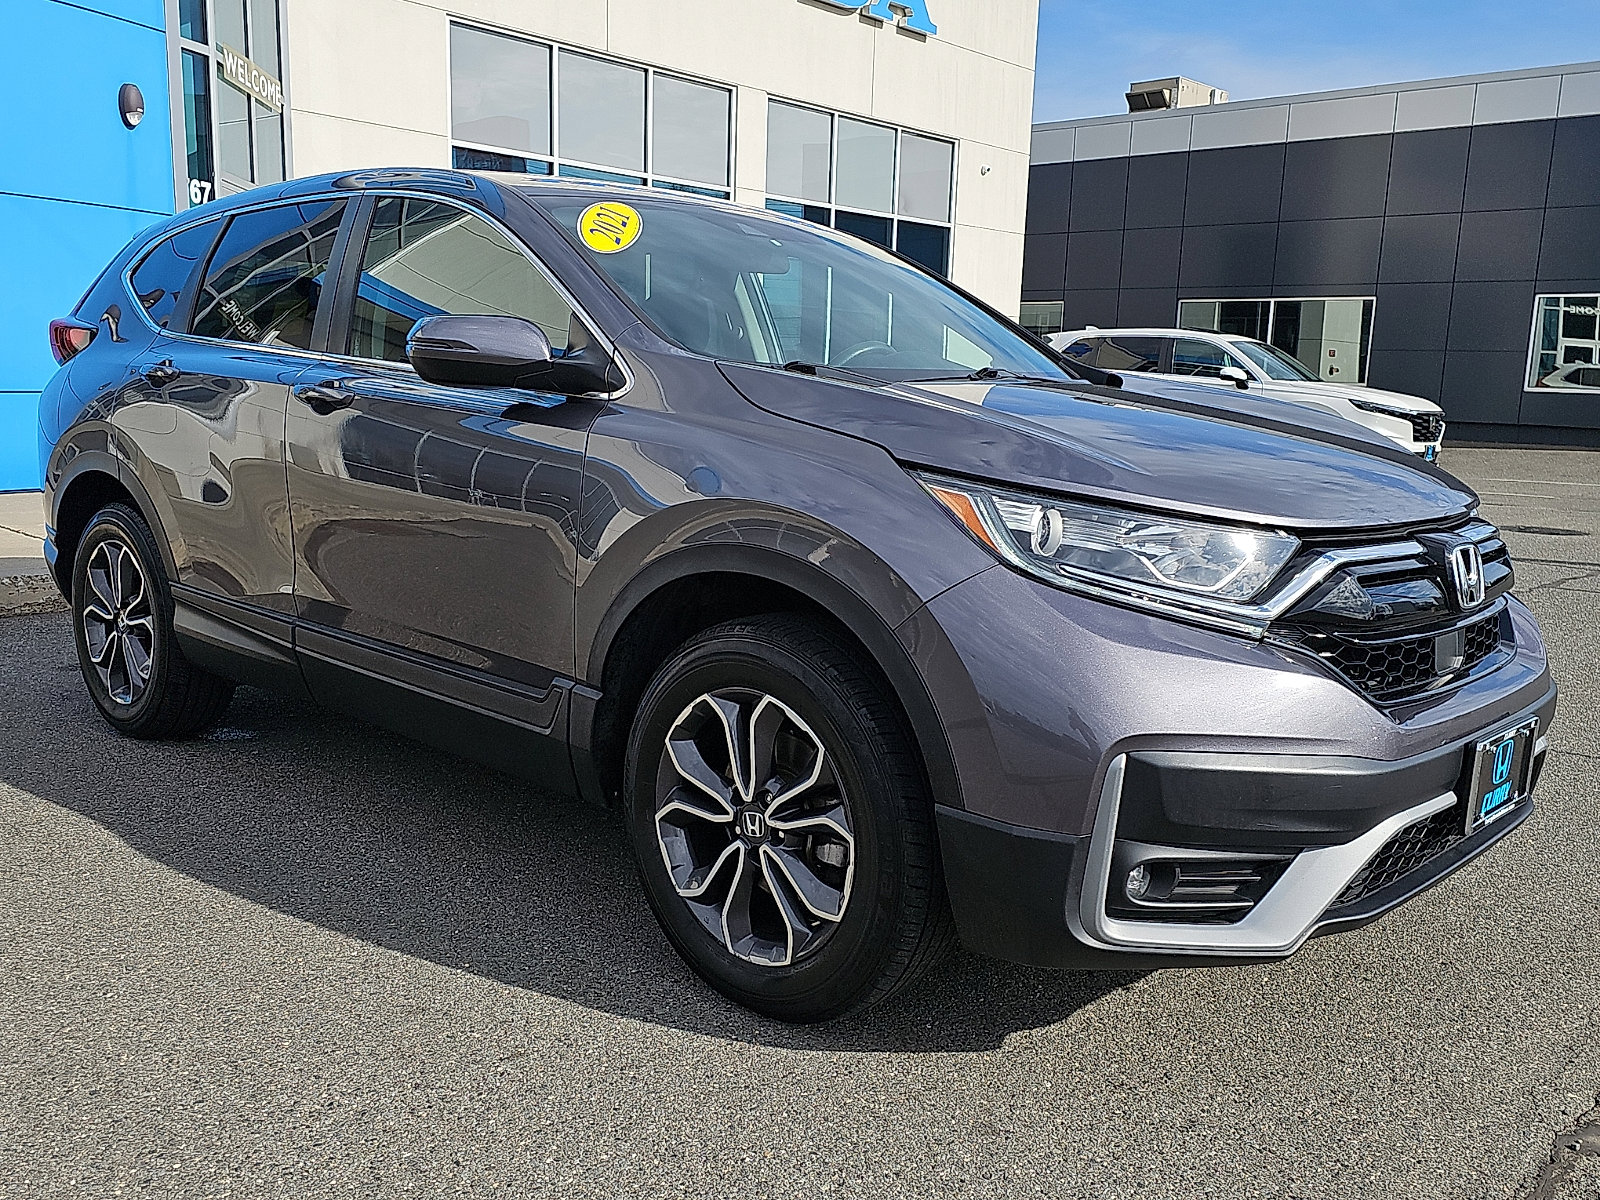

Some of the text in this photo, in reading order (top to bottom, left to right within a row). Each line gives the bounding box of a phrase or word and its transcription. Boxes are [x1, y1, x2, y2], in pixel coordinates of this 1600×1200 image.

[222, 49, 281, 105] WELCOME
[186, 178, 212, 205] 67
[589, 206, 630, 246] 2021
